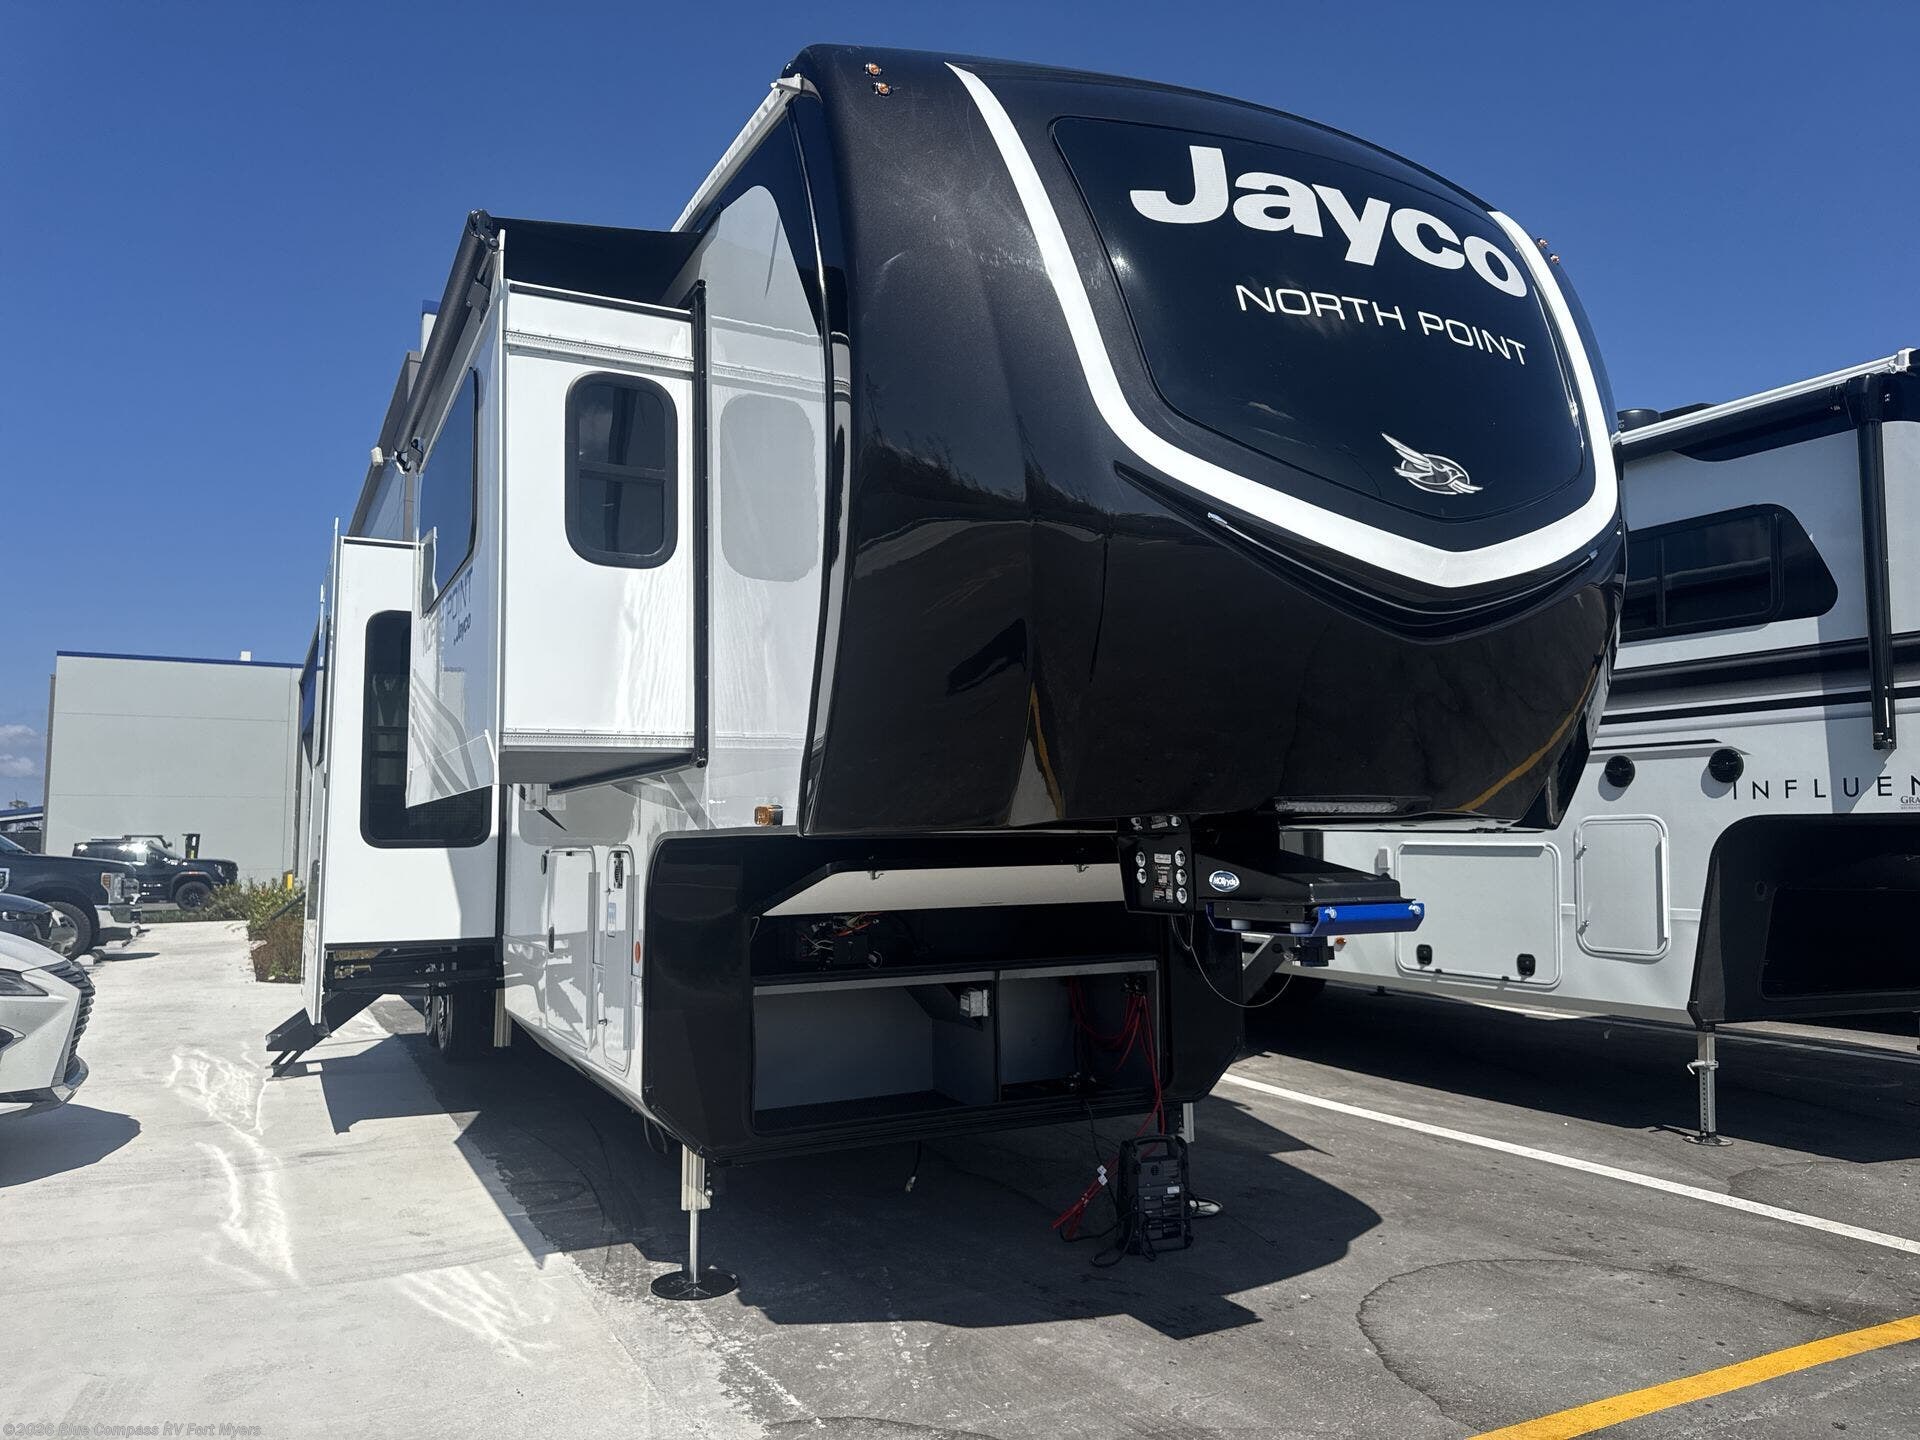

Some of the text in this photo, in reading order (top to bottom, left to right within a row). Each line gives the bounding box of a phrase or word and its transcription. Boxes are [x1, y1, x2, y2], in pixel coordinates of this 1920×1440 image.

[1129, 144, 1528, 298] Jayco
[1235, 284, 1527, 365] NORTH POINT
